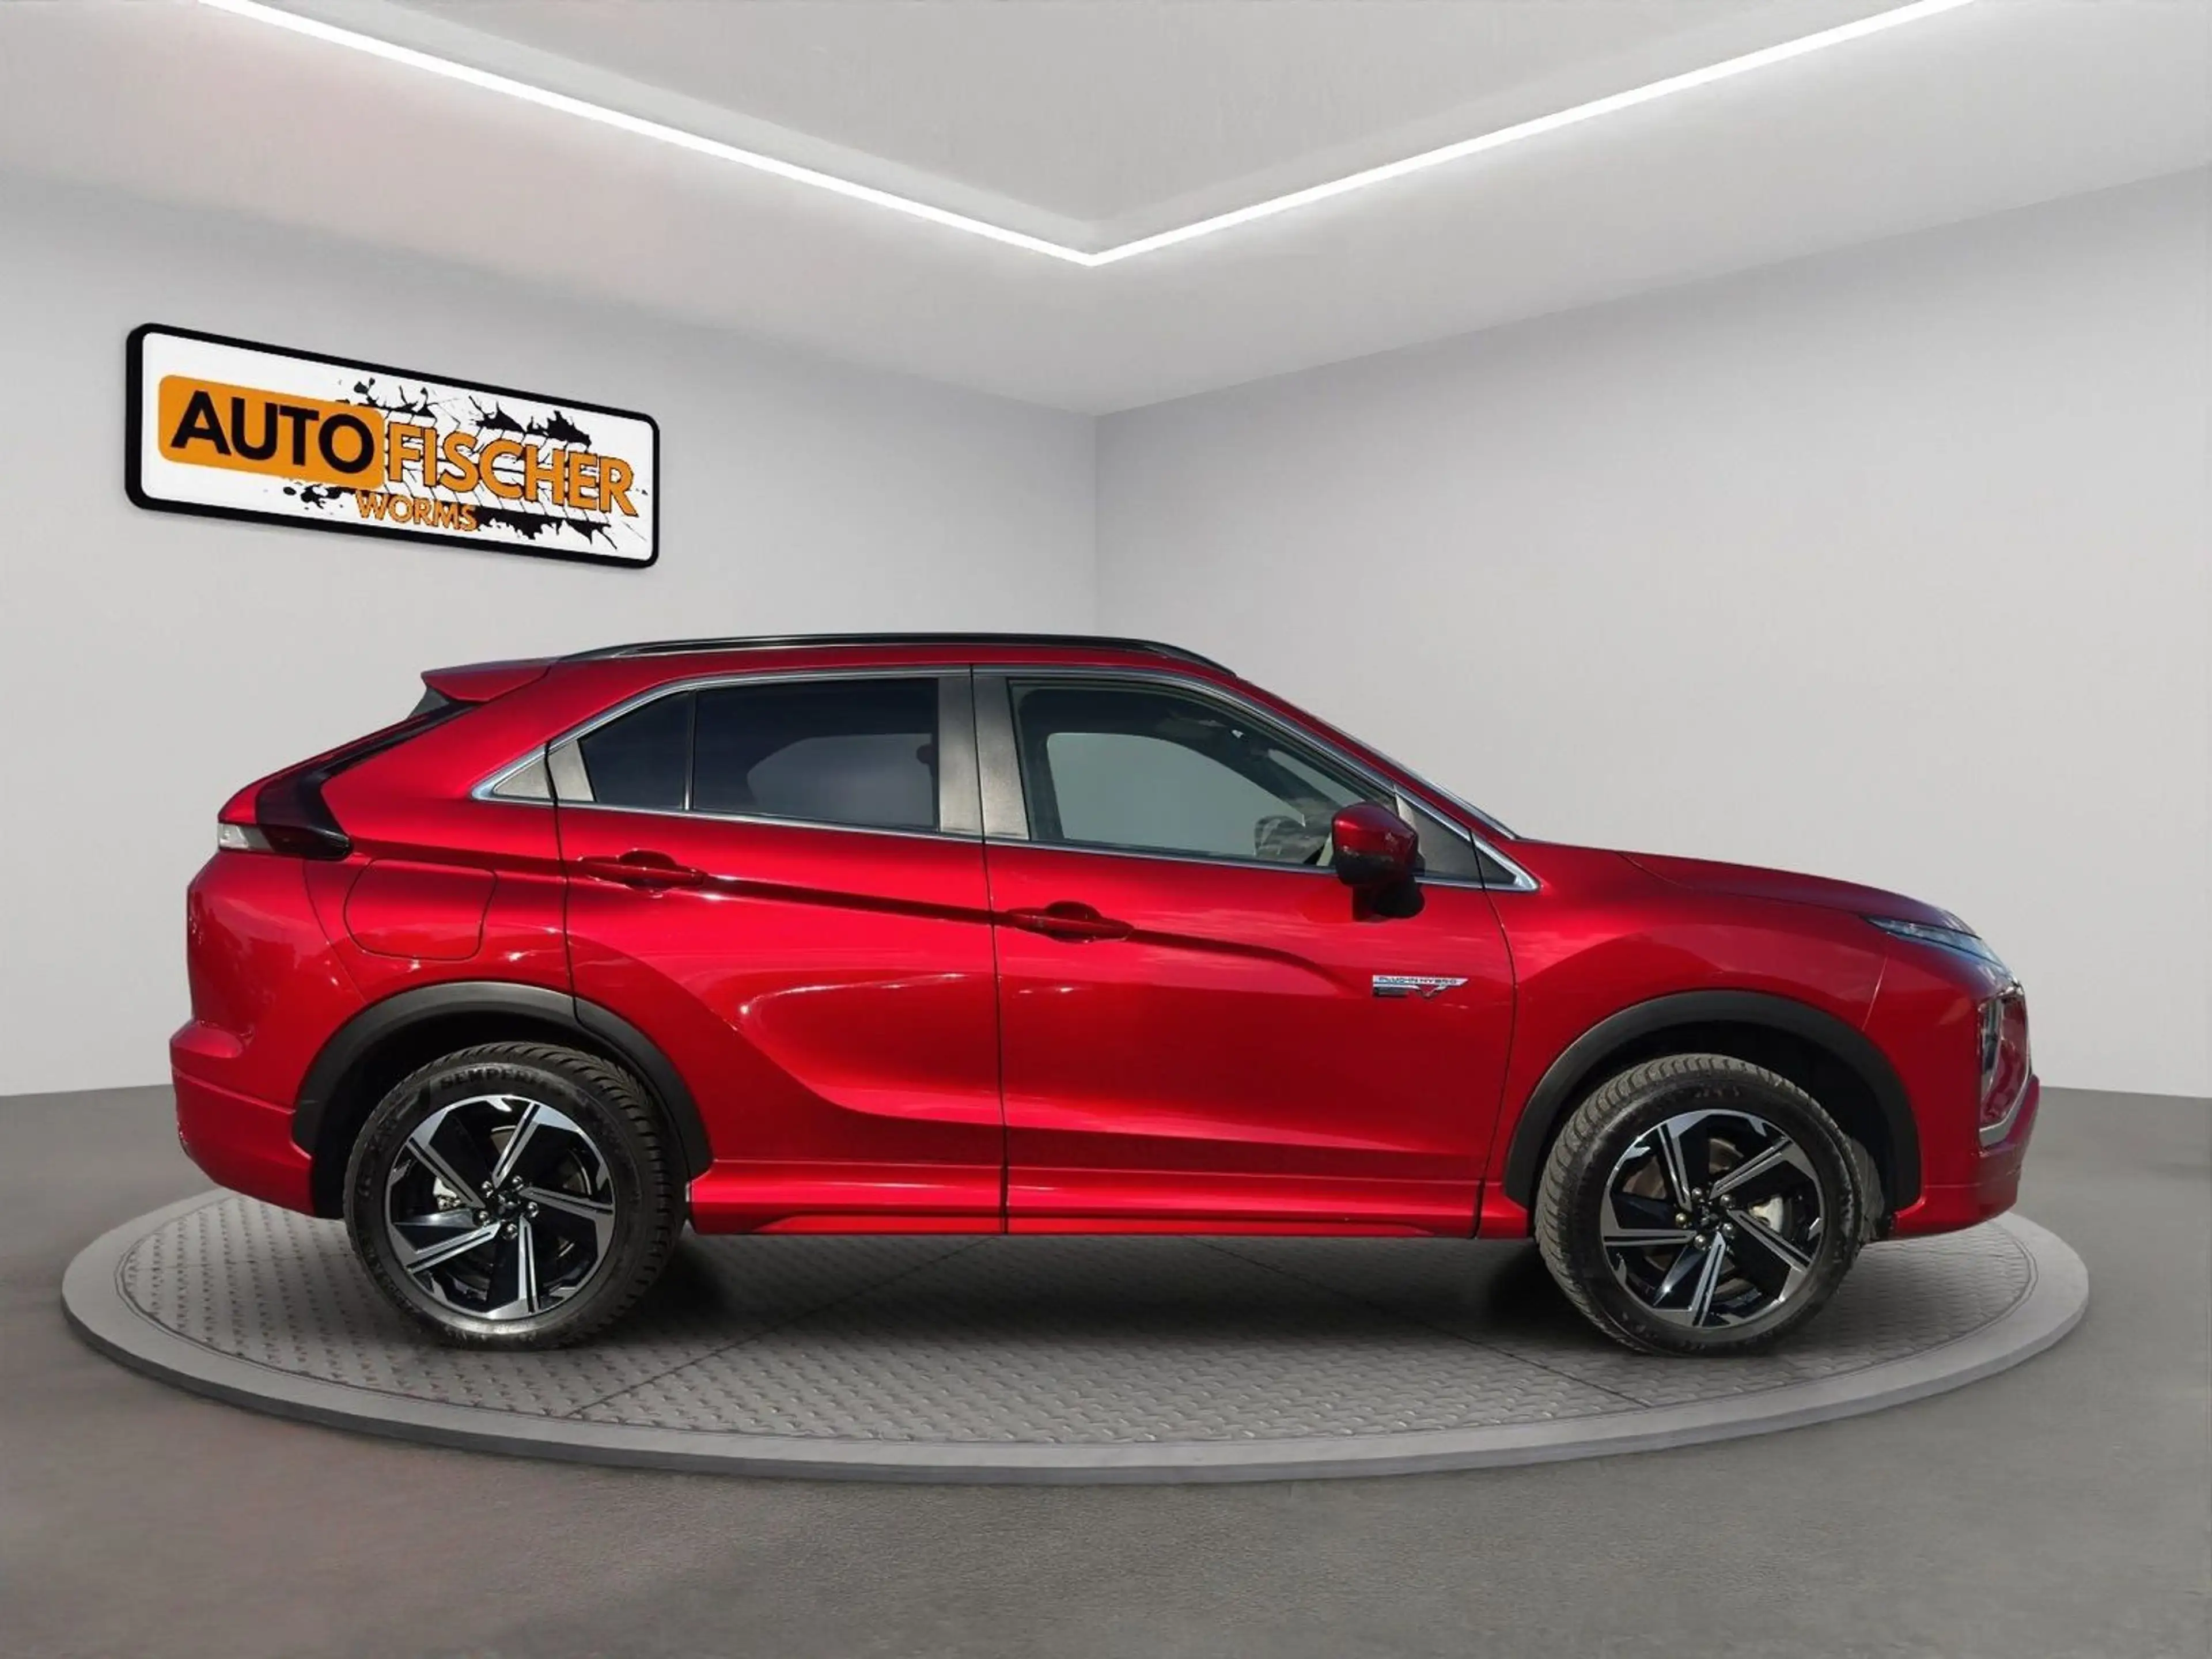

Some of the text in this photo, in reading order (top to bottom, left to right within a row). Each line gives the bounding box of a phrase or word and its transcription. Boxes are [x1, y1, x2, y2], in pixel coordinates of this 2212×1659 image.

[171, 391, 639, 517] AUTO FISCHER
[355, 489, 478, 531] WORMS
